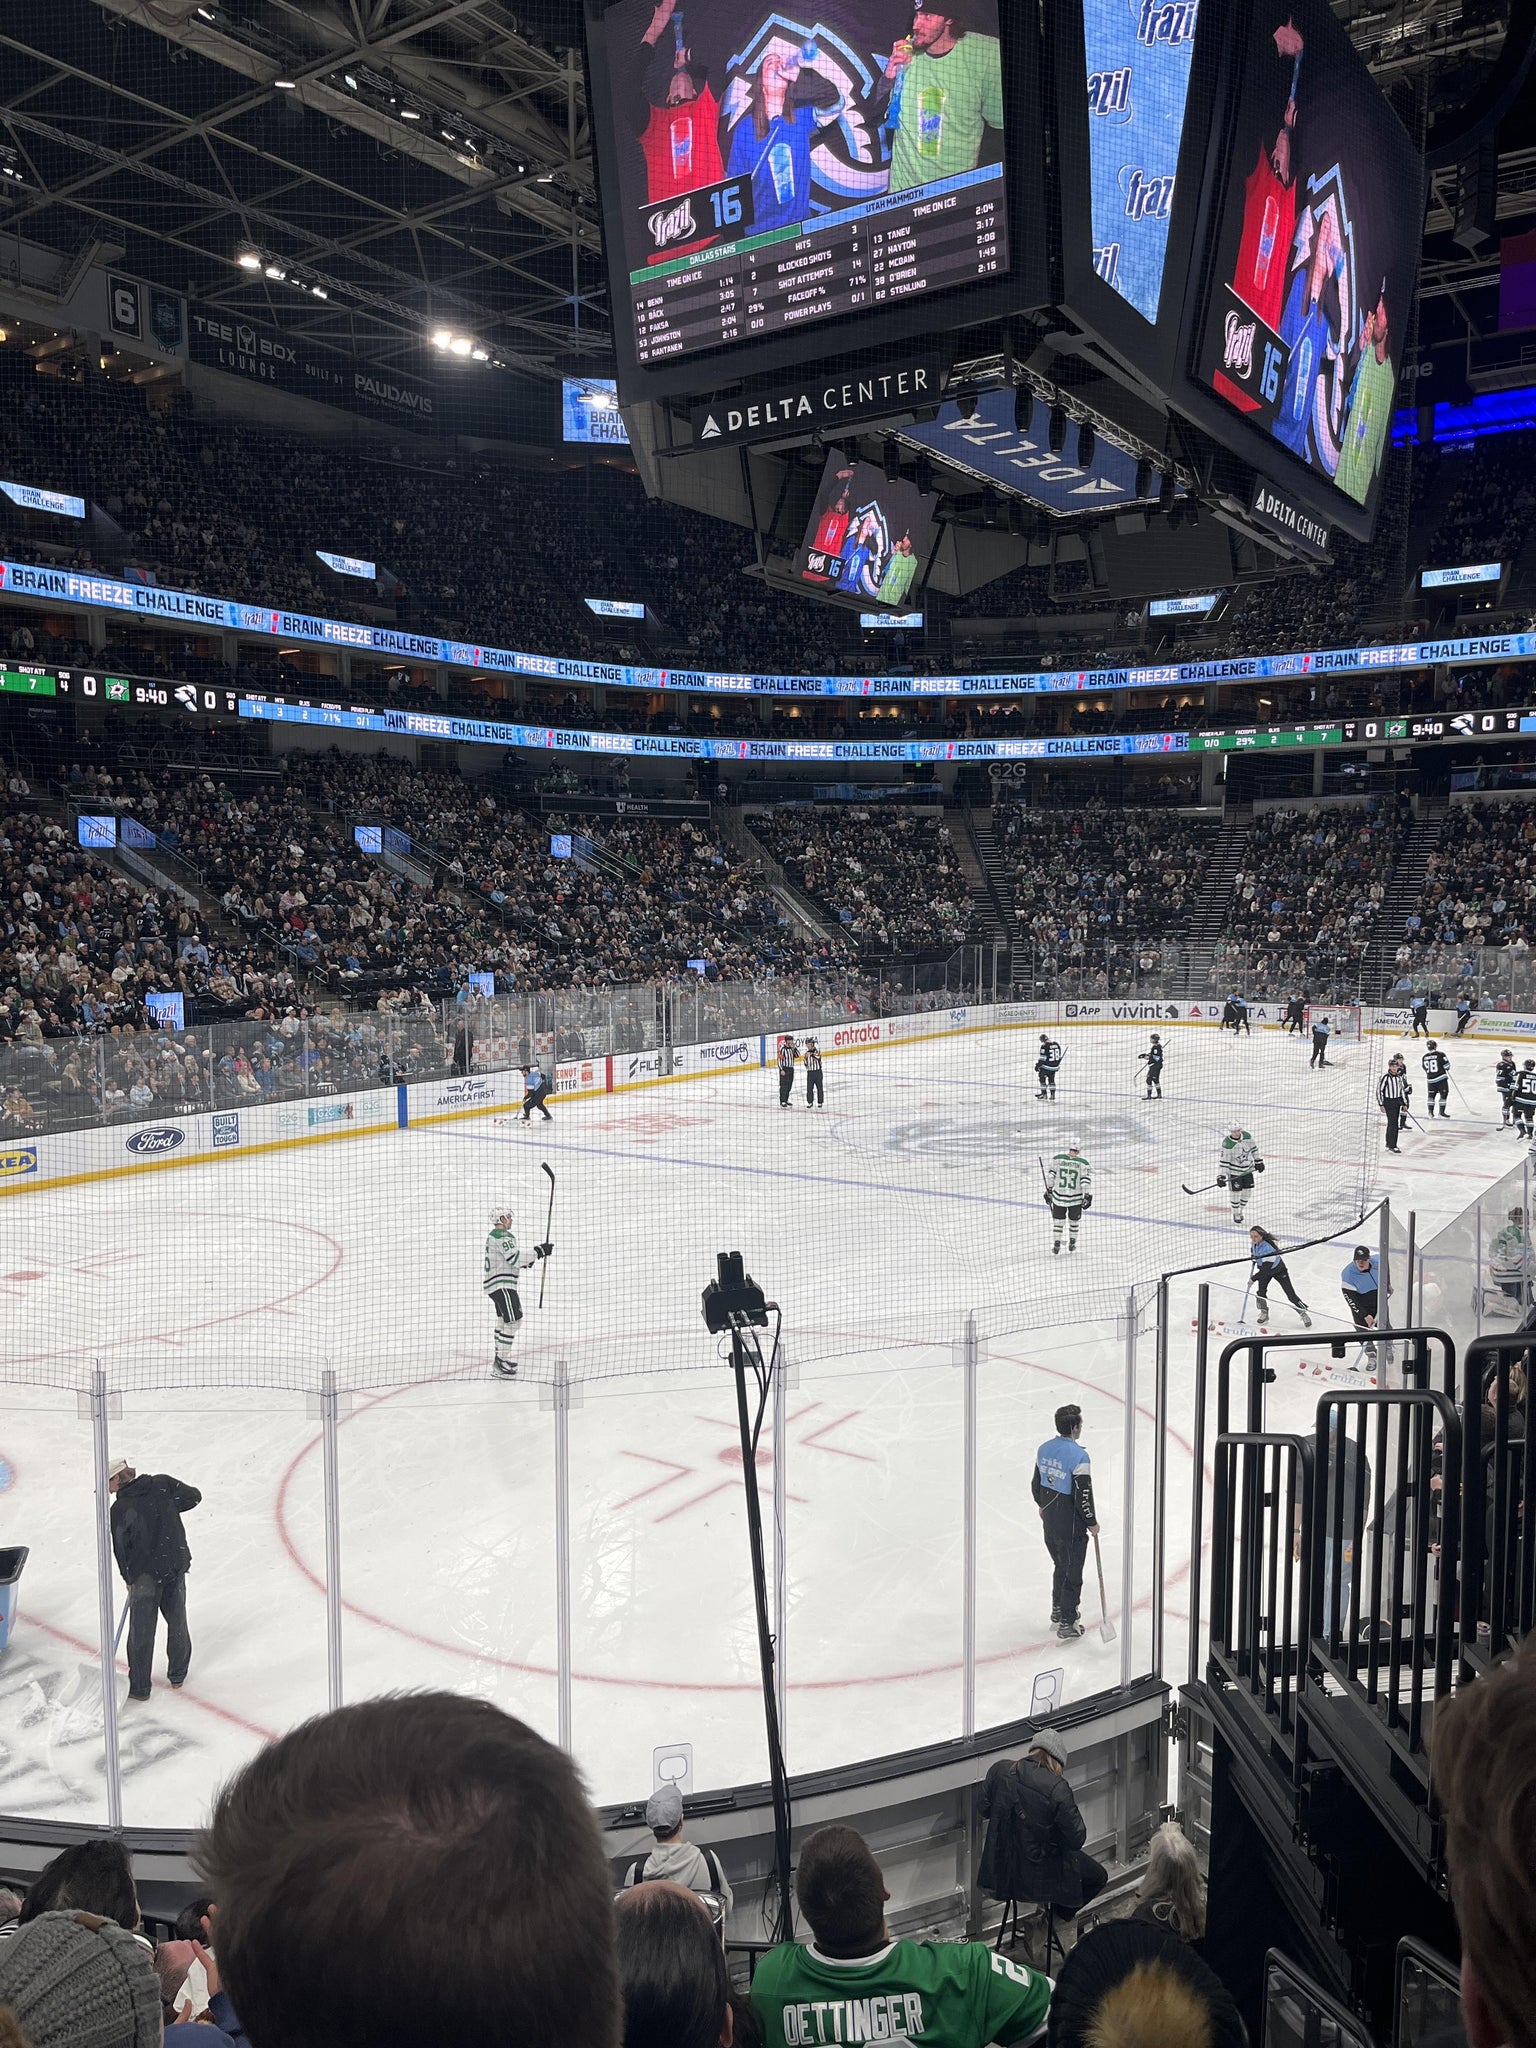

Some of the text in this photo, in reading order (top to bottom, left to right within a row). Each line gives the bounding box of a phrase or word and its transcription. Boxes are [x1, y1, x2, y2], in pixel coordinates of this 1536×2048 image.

[1087, 66, 1132, 115] azil
[866, 189, 924, 213] UTAH MAMMOTH
[1125, 170, 1176, 220] fraz
[710, 185, 742, 228] 16
[913, 197, 957, 218] TIME ON ICE
[654, 198, 691, 247] frazil
[873, 203, 994, 244] 13 TANEV 2:04
[750, 225, 858, 264] 4 HITS 3
[873, 217, 995, 259] 27 HAYTON 3:17
[690, 244, 736, 266] DALLAS STARS
[751, 243, 858, 281] 2 BLOCKED SHOTS 2
[874, 232, 996, 273] 22 MCBAIN 2:08
[874, 246, 996, 286] 38 O'BRIEN 1:49
[666, 270, 703, 289] TIME ON ICE
[752, 259, 862, 297] 7 SHOT ATTEMPTS 14
[875, 260, 997, 300] 82 STENLUND 2:16
[636, 276, 734, 311] 14 BENN 1:14
[748, 275, 867, 314] 29% FACEOFF % 71%
[114, 288, 136, 325] 6
[637, 314, 646, 323] 10
[719, 290, 735, 301] 3:05
[751, 291, 865, 329] 0/0 POWER PLAYS 0/1
[638, 302, 736, 336] 12 FAKSA 2:47
[193, 315, 233, 343] TEE
[260, 338, 297, 365] BOX
[638, 315, 737, 348] 53 JOHNSTON 2:04
[640, 328, 738, 360] 96 RANTANEN 2:16
[219, 347, 276, 380] LOUNGE
[305, 363, 329, 381] BUILT
[1259, 341, 1283, 403] 16
[727, 368, 928, 432] DELTA CENTER
[942, 412, 1087, 482] DELTA
[22, 495, 65, 511] CHALLENGE
[1265, 493, 1329, 550] DELTA CENTER
[828, 558, 842, 578] 16
[12, 568, 66, 595] BRAIN
[68, 577, 133, 606] FREEZE
[135, 589, 224, 620] CHALLENGE
[283, 616, 439, 656] BRAIN FREEZE CHALLENGE
[1315, 638, 1511, 669] BRAIN FREEZE CHALLENGE
[482, 650, 622, 682] BRAIN FREEZE CHALLENGE
[1088, 661, 1257, 687] BRAIN FREEZE CHALLENGE
[29, 678, 37, 690] 7
[60, 680, 69, 693] 4
[83, 676, 97, 696] 0
[670, 673, 823, 693] BRAIN FREEZE CHALLENGE
[873, 676, 1036, 693] BRAIN FREEZE CHALLENGE
[135, 687, 168, 705] 9:40
[204, 690, 217, 710] 0
[227, 700, 235, 711] 8
[251, 704, 263, 715] 14
[277, 707, 284, 718] 3
[302, 710, 308, 720] 2
[323, 712, 342, 724] 71%
[356, 716, 370, 727] 0/1
[383, 709, 513, 741] AIN FREEZE CHALLENGE
[1365, 723, 1377, 738] 0
[1412, 722, 1443, 736] 9:40
[1481, 715, 1495, 731] 0
[1507, 720, 1515, 729] 8
[556, 732, 701, 754] BRAIN FREEZE CHALLENGE
[1204, 738, 1220, 748] 0/0
[1236, 737, 1256, 746] 29%
[1270, 735, 1277, 744] 2
[1296, 734, 1303, 743] 4
[1321, 732, 1327, 741] 7
[1346, 729, 1353, 739] 4
[750, 744, 906, 758] BRAIN FREEZE CHALLENGE
[957, 739, 1121, 757] BRAIN FREEZE CHALLENGE
[987, 761, 1027, 779] G2G
[1112, 1002, 1163, 1019] vivint
[1208, 1005, 1268, 1019] DTA
[1374, 1018, 1407, 1026] AMERICA
[834, 1024, 880, 1046] entrata
[1048, 1048, 1061, 1062] 38
[1424, 1060, 1439, 1074] 98
[436, 1093, 473, 1106] AMERICA
[473, 1089, 496, 1100] FIRST
[215, 1115, 236, 1127] BUILT
[317, 1107, 335, 1118] G2G
[137, 1129, 174, 1151] Ford
[215, 1134, 237, 1145] TOUGH
[0, 1154, 33, 1169] KEA
[1058, 1168, 1079, 1190] 53
[502, 1239, 516, 1252] 96
[782, 1992, 925, 2047] OETTINGER
